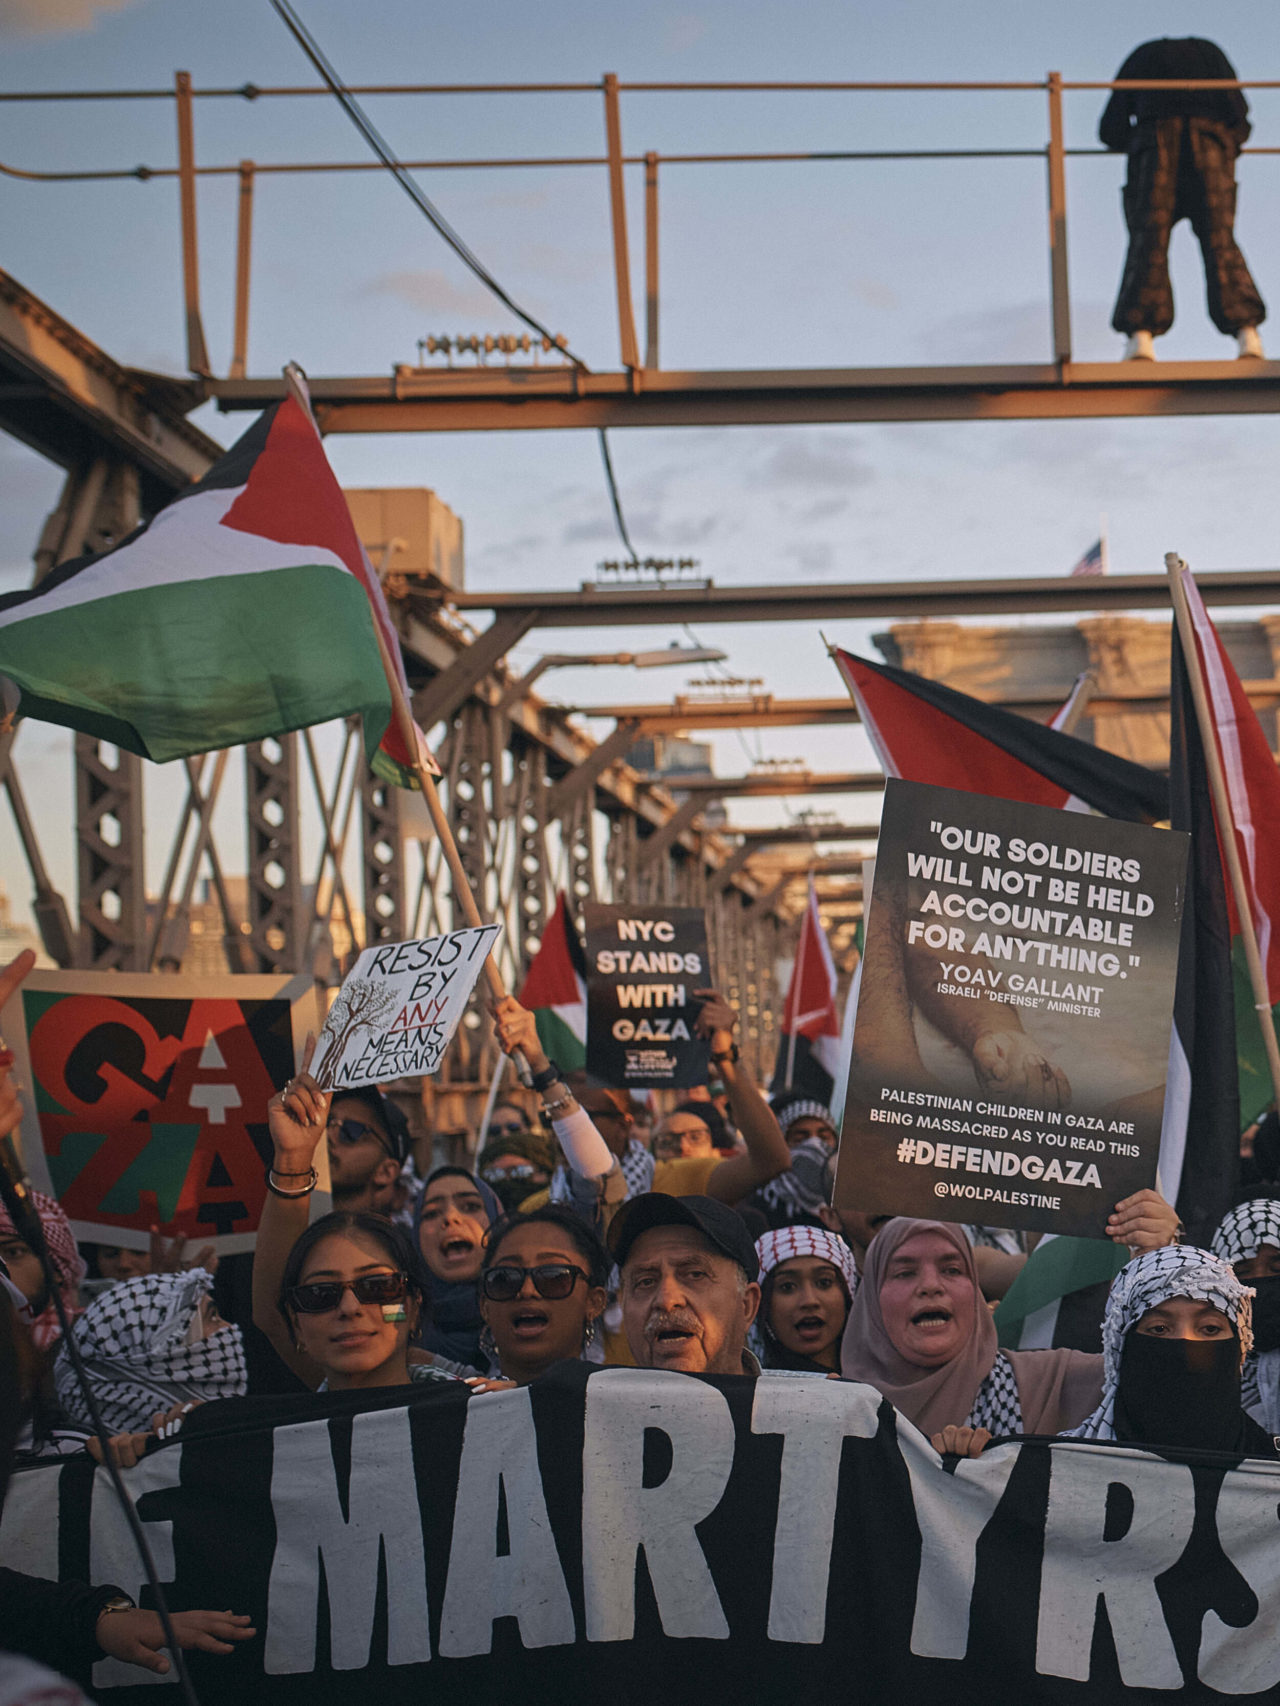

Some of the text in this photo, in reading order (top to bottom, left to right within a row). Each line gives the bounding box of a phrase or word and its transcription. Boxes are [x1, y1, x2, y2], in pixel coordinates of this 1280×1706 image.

[930, 821, 1141, 882] "OUR SOLDIERS
[908, 853, 1154, 917] WILL NOT BE HELD
[617, 919, 675, 942] NYC
[920, 890, 1134, 947] ACCOUNTABLE
[367, 926, 498, 977] RESIST
[597, 950, 702, 974] STANDS
[908, 920, 1140, 979] FOR ANYTHING."
[408, 968, 457, 1001] BY
[616, 984, 686, 1008] WITH
[937, 983, 1101, 1018] ISRAELI “DEFENSE” MINISTER
[940, 962, 1104, 1004] YOAV GALLANT
[391, 996, 449, 1030] ANY
[612, 1018, 691, 1041] GAZA
[363, 1021, 446, 1056] MEANS
[337, 1042, 447, 1084] NECESSARY
[881, 1088, 1135, 1136] PALESTINIAN CHILDREN IN GAZA ARE
[870, 1109, 1140, 1158] BEING MASSACRED AS YOU READ THIS
[897, 1138, 1102, 1188] #DEFENDGAZA
[934, 1182, 1061, 1210] @WOLPALESTINE
